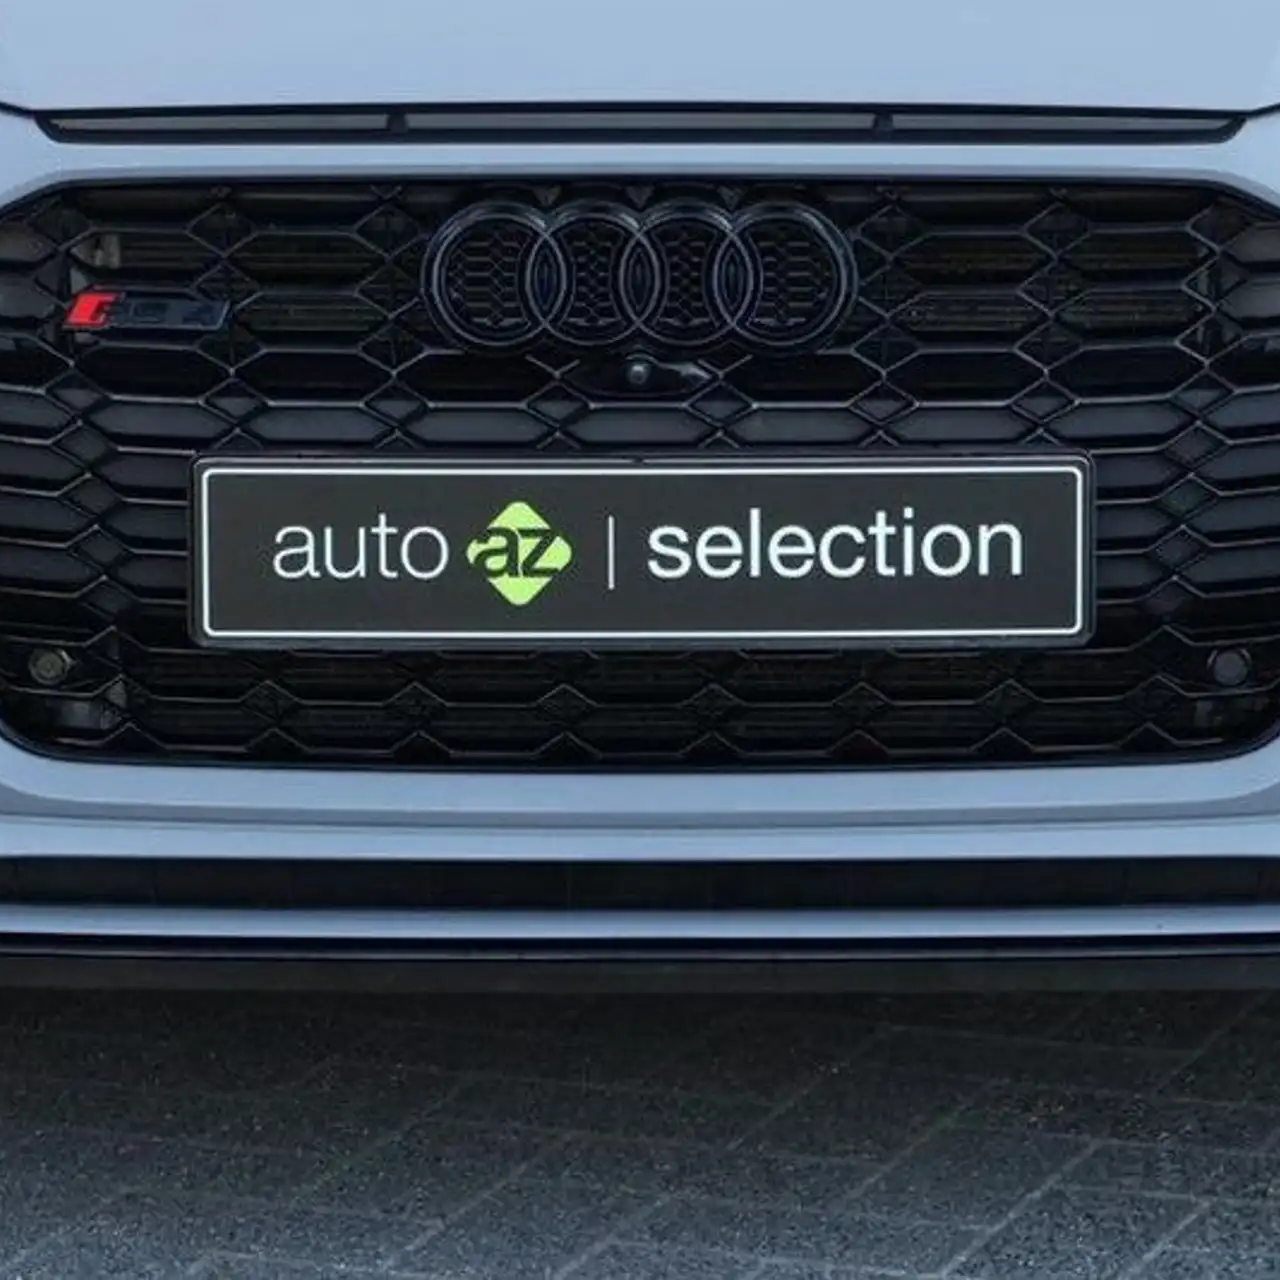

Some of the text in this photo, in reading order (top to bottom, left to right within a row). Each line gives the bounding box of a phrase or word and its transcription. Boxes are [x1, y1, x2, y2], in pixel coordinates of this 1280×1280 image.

[272, 506, 1022, 580] auto az selection
